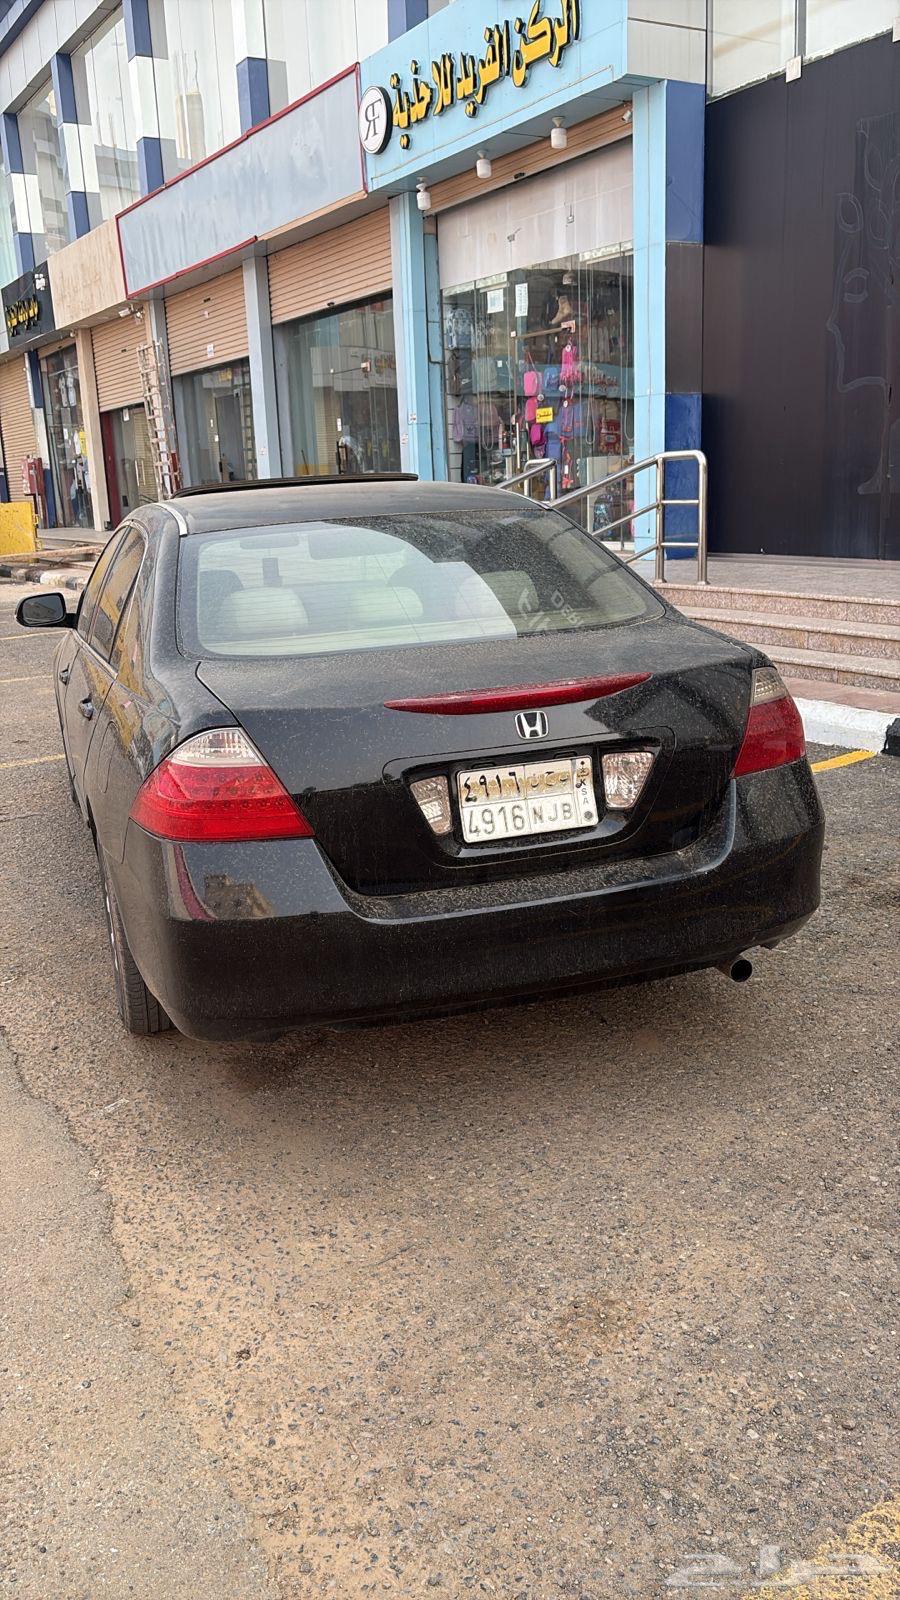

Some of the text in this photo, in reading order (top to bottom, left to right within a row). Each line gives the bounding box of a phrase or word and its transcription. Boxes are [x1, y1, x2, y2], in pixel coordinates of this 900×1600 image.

[456, 20, 511, 118] الفريد
[512, 0, 580, 87] الركن
[468, 802, 574, 837] 4916 NJB
